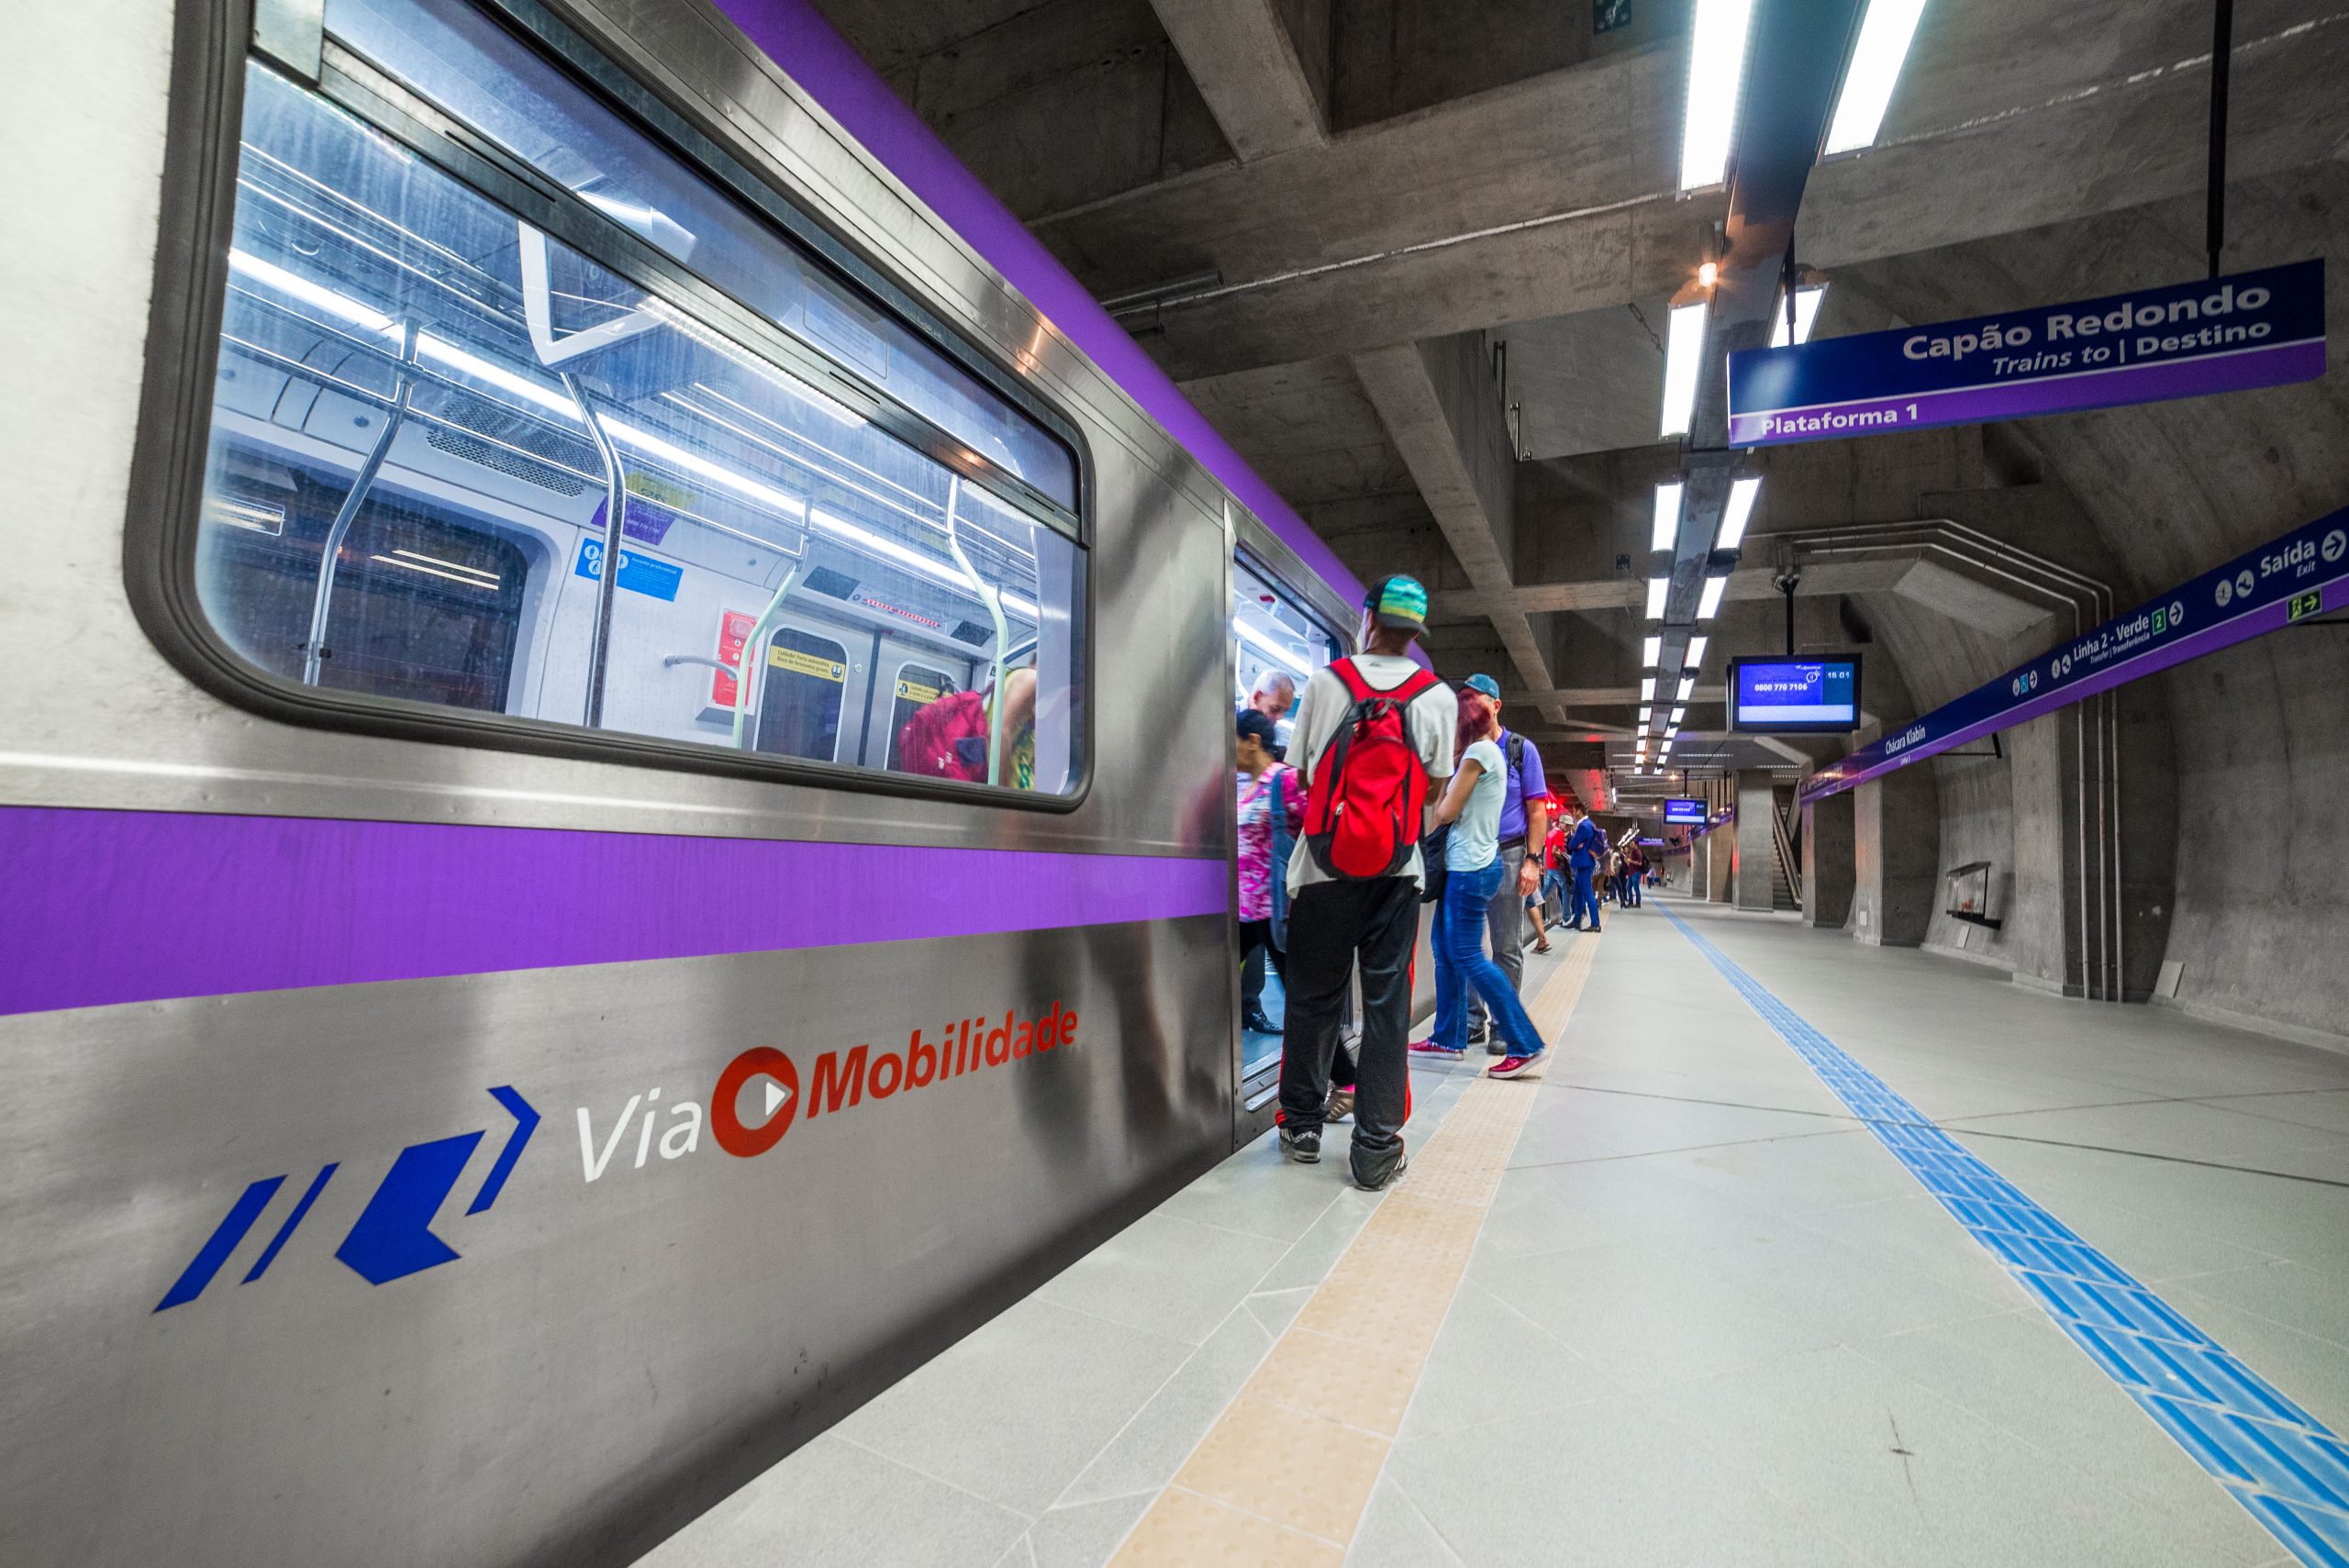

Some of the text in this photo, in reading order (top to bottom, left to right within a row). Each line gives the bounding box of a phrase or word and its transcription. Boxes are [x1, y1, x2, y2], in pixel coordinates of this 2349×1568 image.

[1903, 285, 2271, 361] Capão Redondo
[1992, 351, 2072, 375] Trains
[2081, 346, 2110, 364] to
[2136, 322, 2272, 356] Destino
[1761, 404, 1918, 436] Plataforma 1
[2260, 539, 2316, 578] Saída
[2297, 561, 2315, 578] Exit
[2074, 640, 2099, 662] Linha
[2101, 633, 2109, 650] 2
[2116, 614, 2149, 641] Verde
[2155, 615, 2163, 628] 2
[2090, 651, 2110, 664] Transfer
[2112, 631, 2151, 655] Transferência
[1886, 724, 1926, 755] Chácara Klabin
